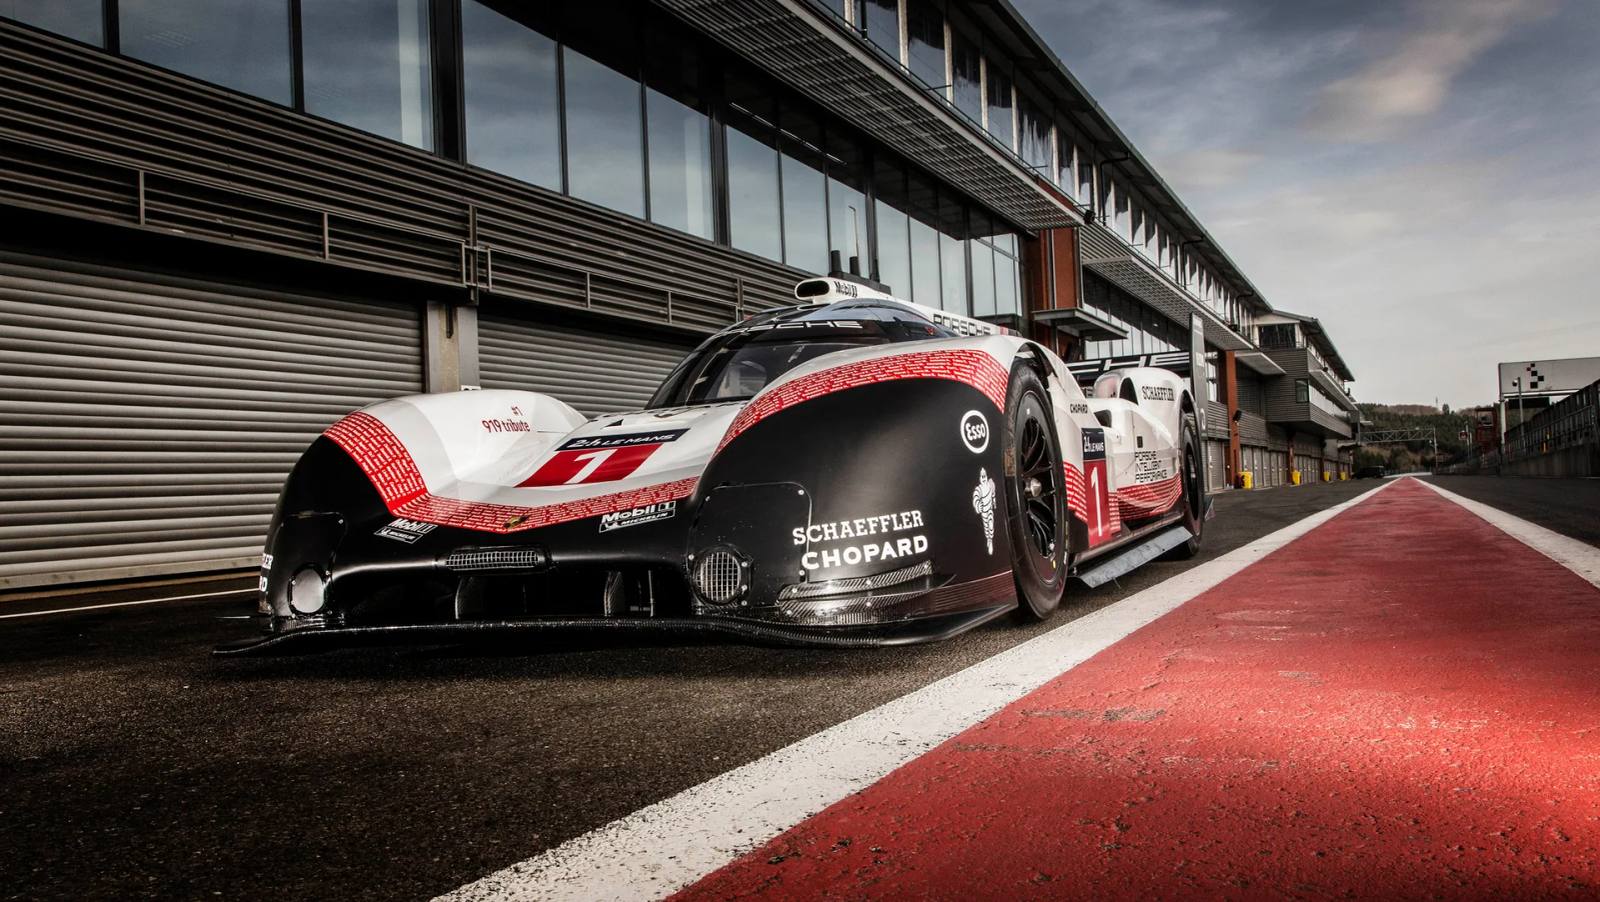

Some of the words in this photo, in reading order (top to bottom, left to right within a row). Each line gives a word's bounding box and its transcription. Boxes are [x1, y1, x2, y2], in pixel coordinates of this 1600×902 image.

[1142, 386, 1175, 402] SCHAEFFLER
[511, 406, 524, 416] #1
[1070, 404, 1088, 414] CHOPARD
[482, 419, 502, 432] 919
[502, 418, 530, 432] tribute
[623, 434, 676, 444] MANS
[1134, 450, 1156, 461] PORSCHE
[563, 448, 618, 484] 1
[1091, 466, 1102, 536] 1
[601, 504, 656, 523] Mobil
[621, 512, 669, 526] MICHELIN
[388, 518, 427, 532] Mobil
[792, 510, 924, 546] SCHAEFFLER
[801, 534, 928, 570] CHOPARD
